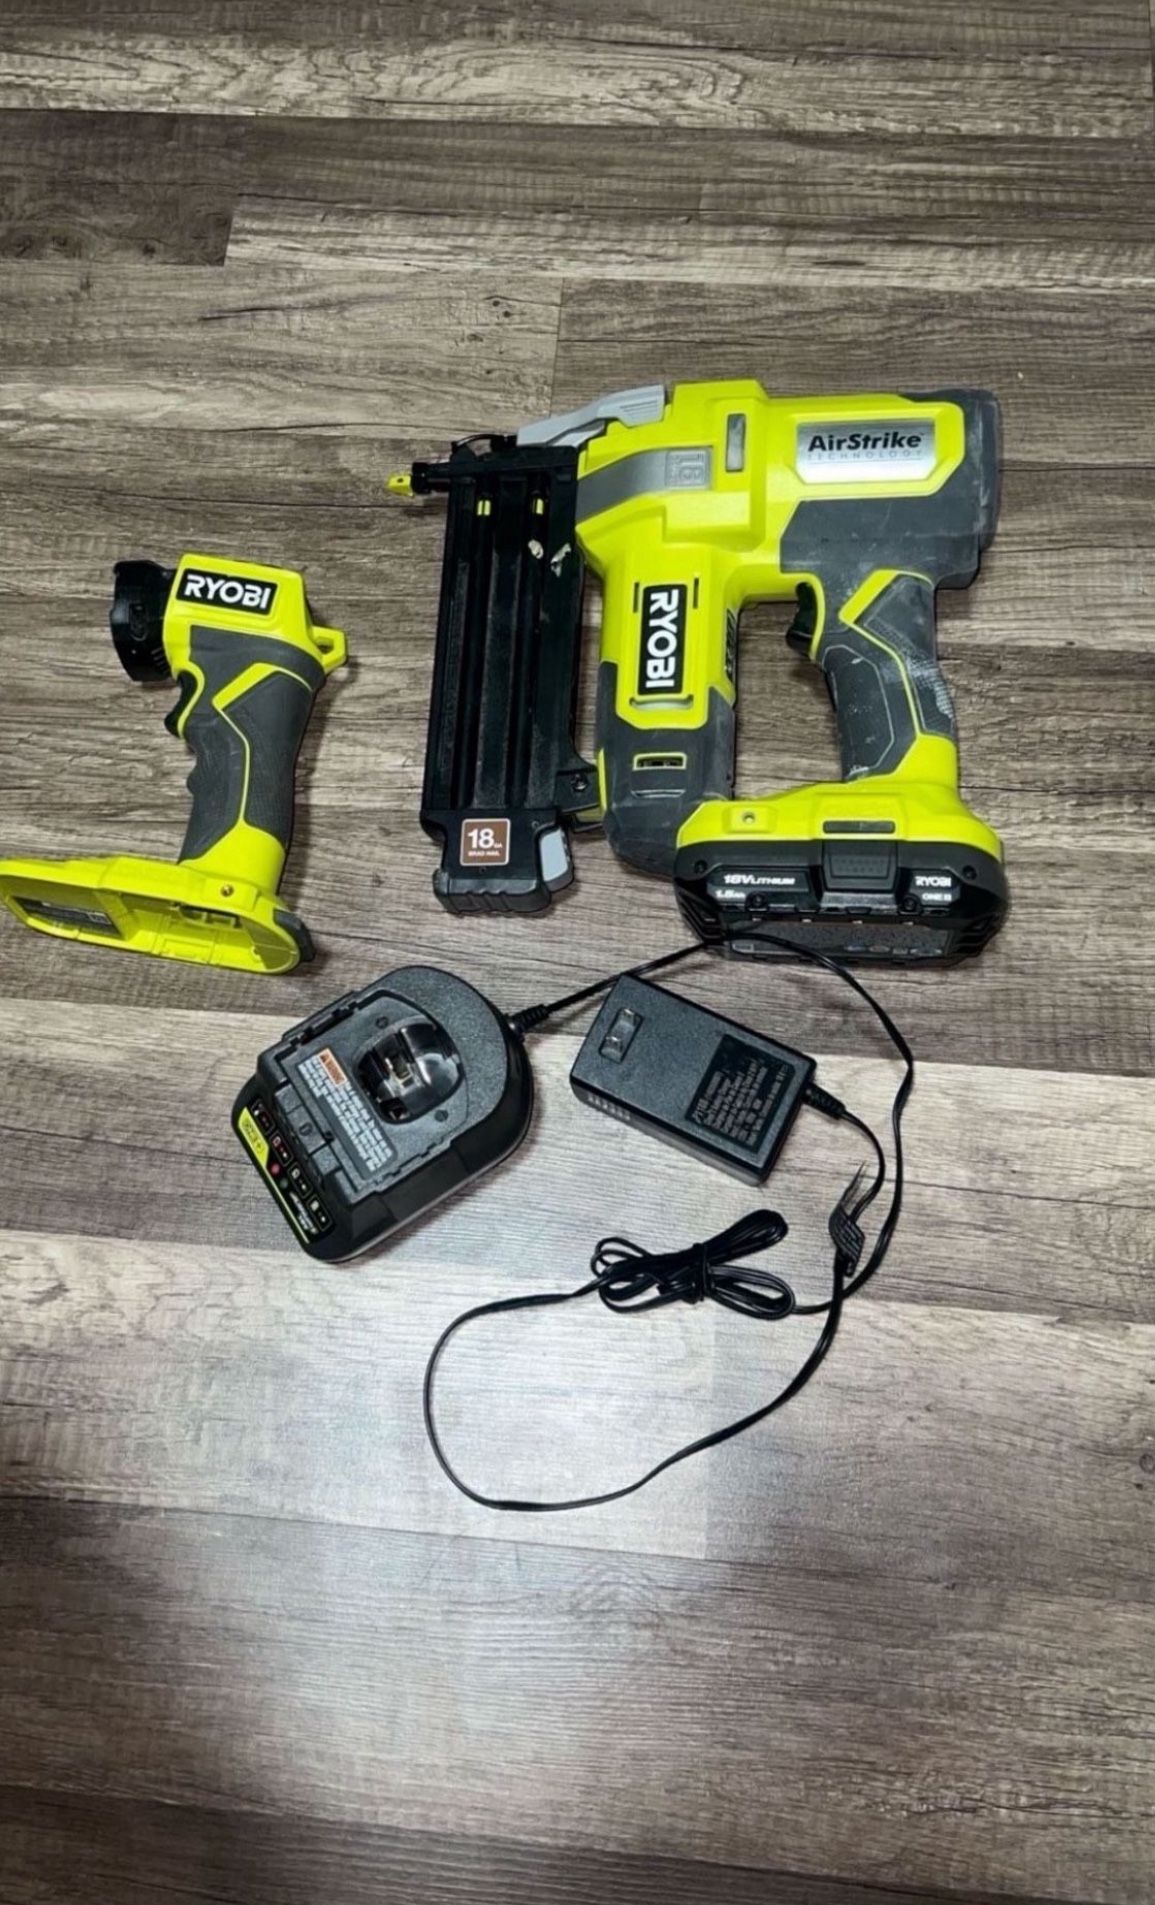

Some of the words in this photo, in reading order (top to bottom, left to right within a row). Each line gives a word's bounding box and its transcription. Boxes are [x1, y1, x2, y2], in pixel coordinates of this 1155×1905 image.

[807, 431, 922, 452] AirStrike
[184, 573, 271, 610] RYOBI
[645, 589, 679, 688] RYOBI
[915, 875, 952, 888] RYOBI
